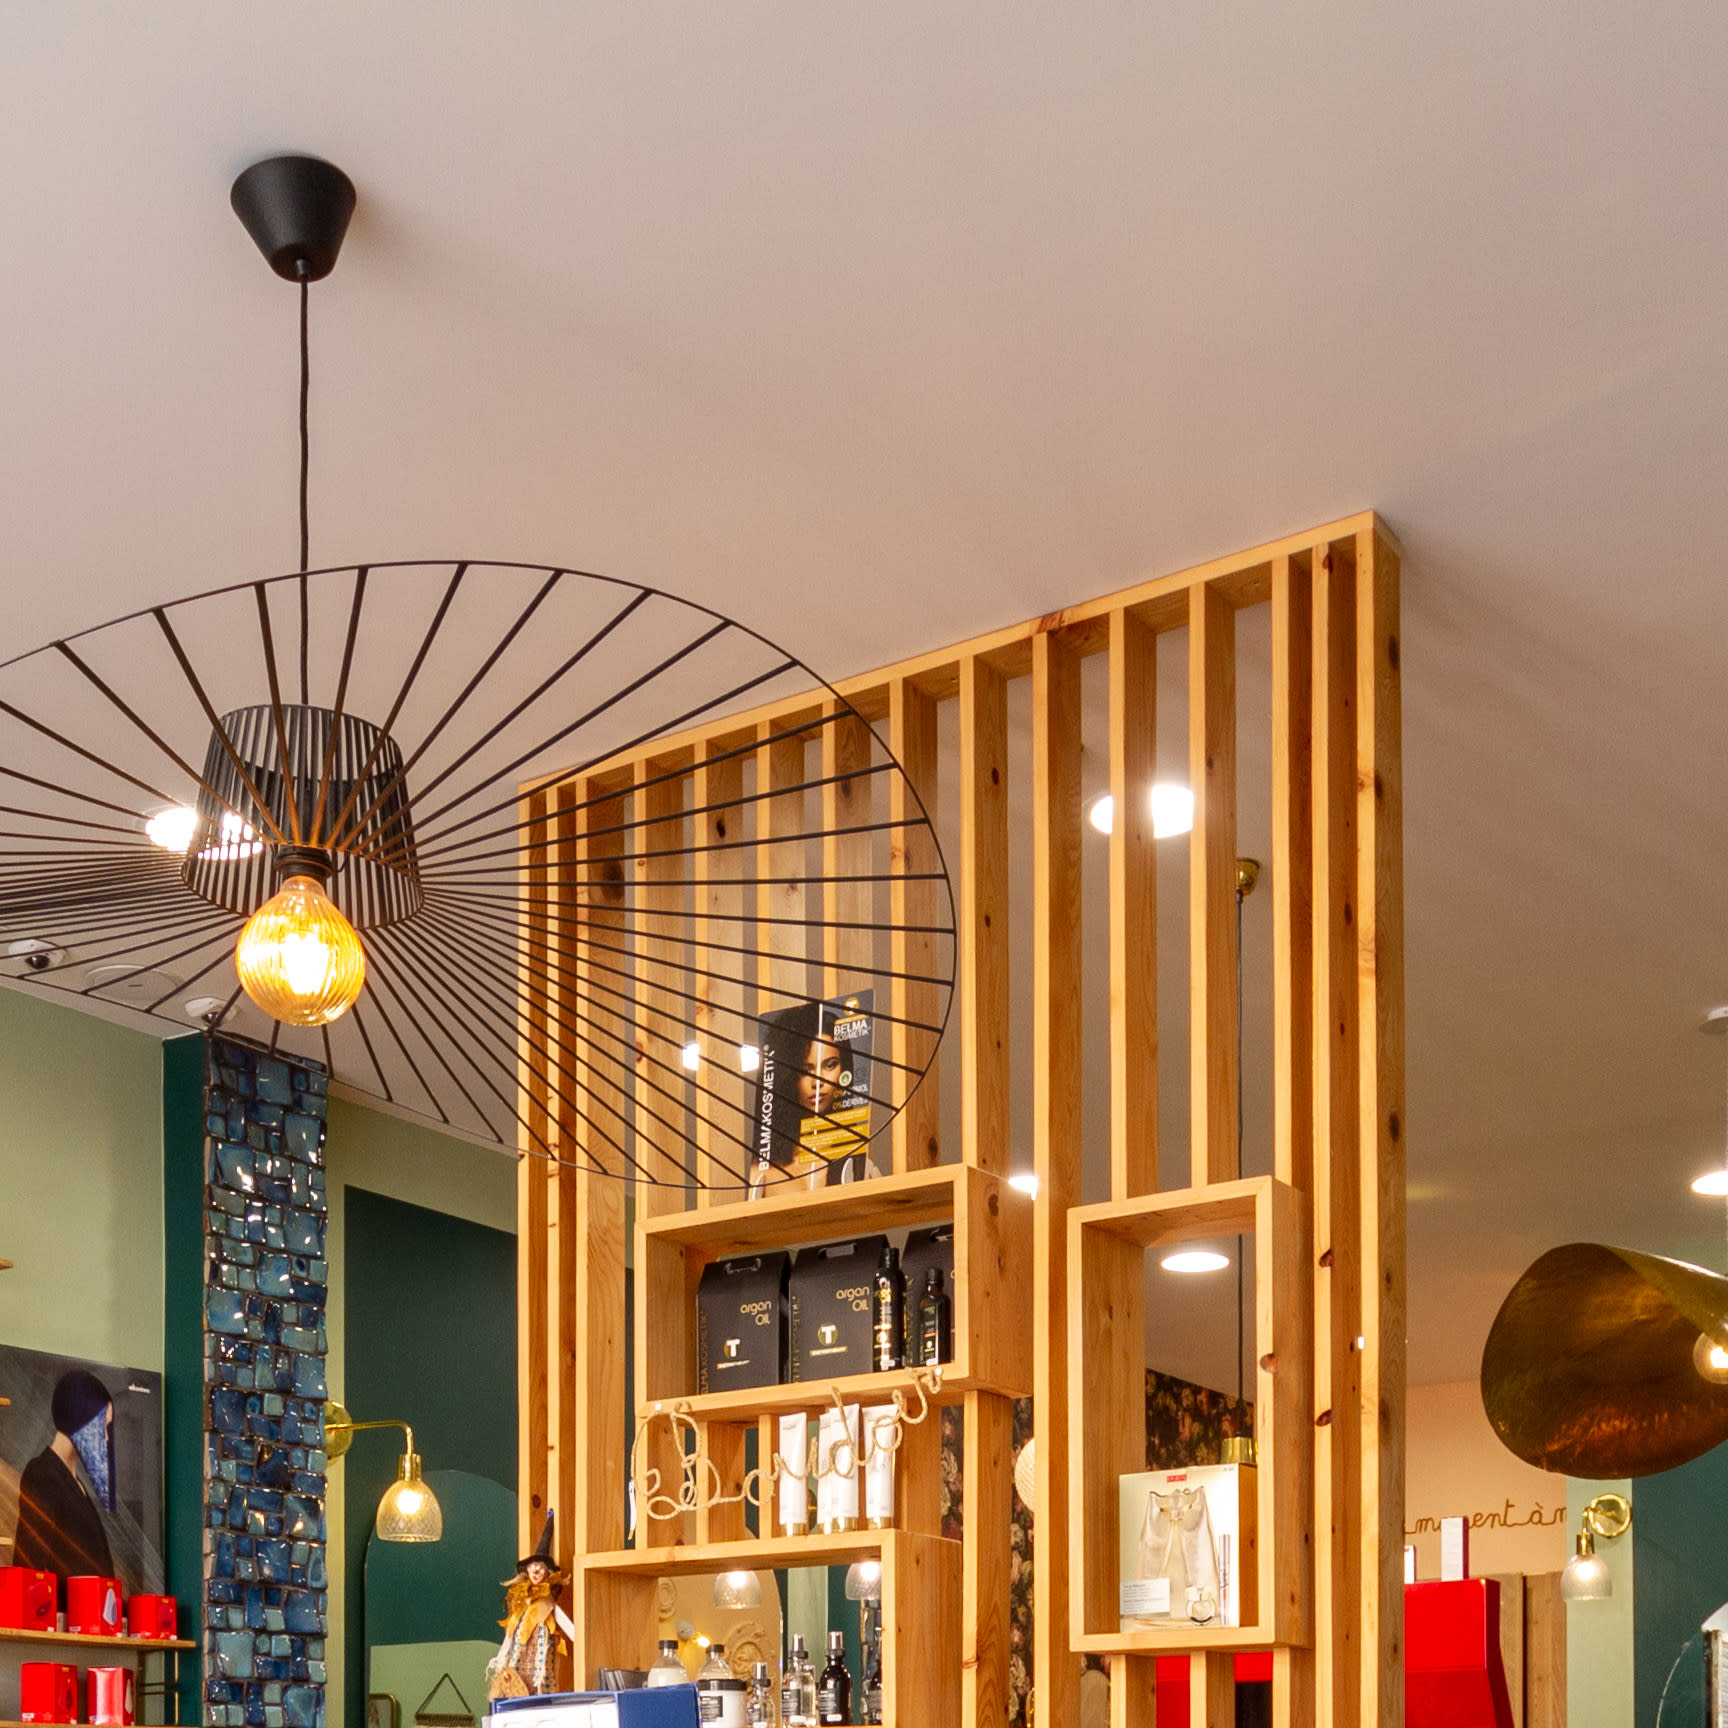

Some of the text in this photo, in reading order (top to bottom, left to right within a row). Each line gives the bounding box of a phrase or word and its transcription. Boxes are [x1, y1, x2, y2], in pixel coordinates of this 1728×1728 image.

[833, 1020, 868, 1036] BELMA
[835, 1285, 871, 1302] argan
[739, 1300, 772, 1316] argan
